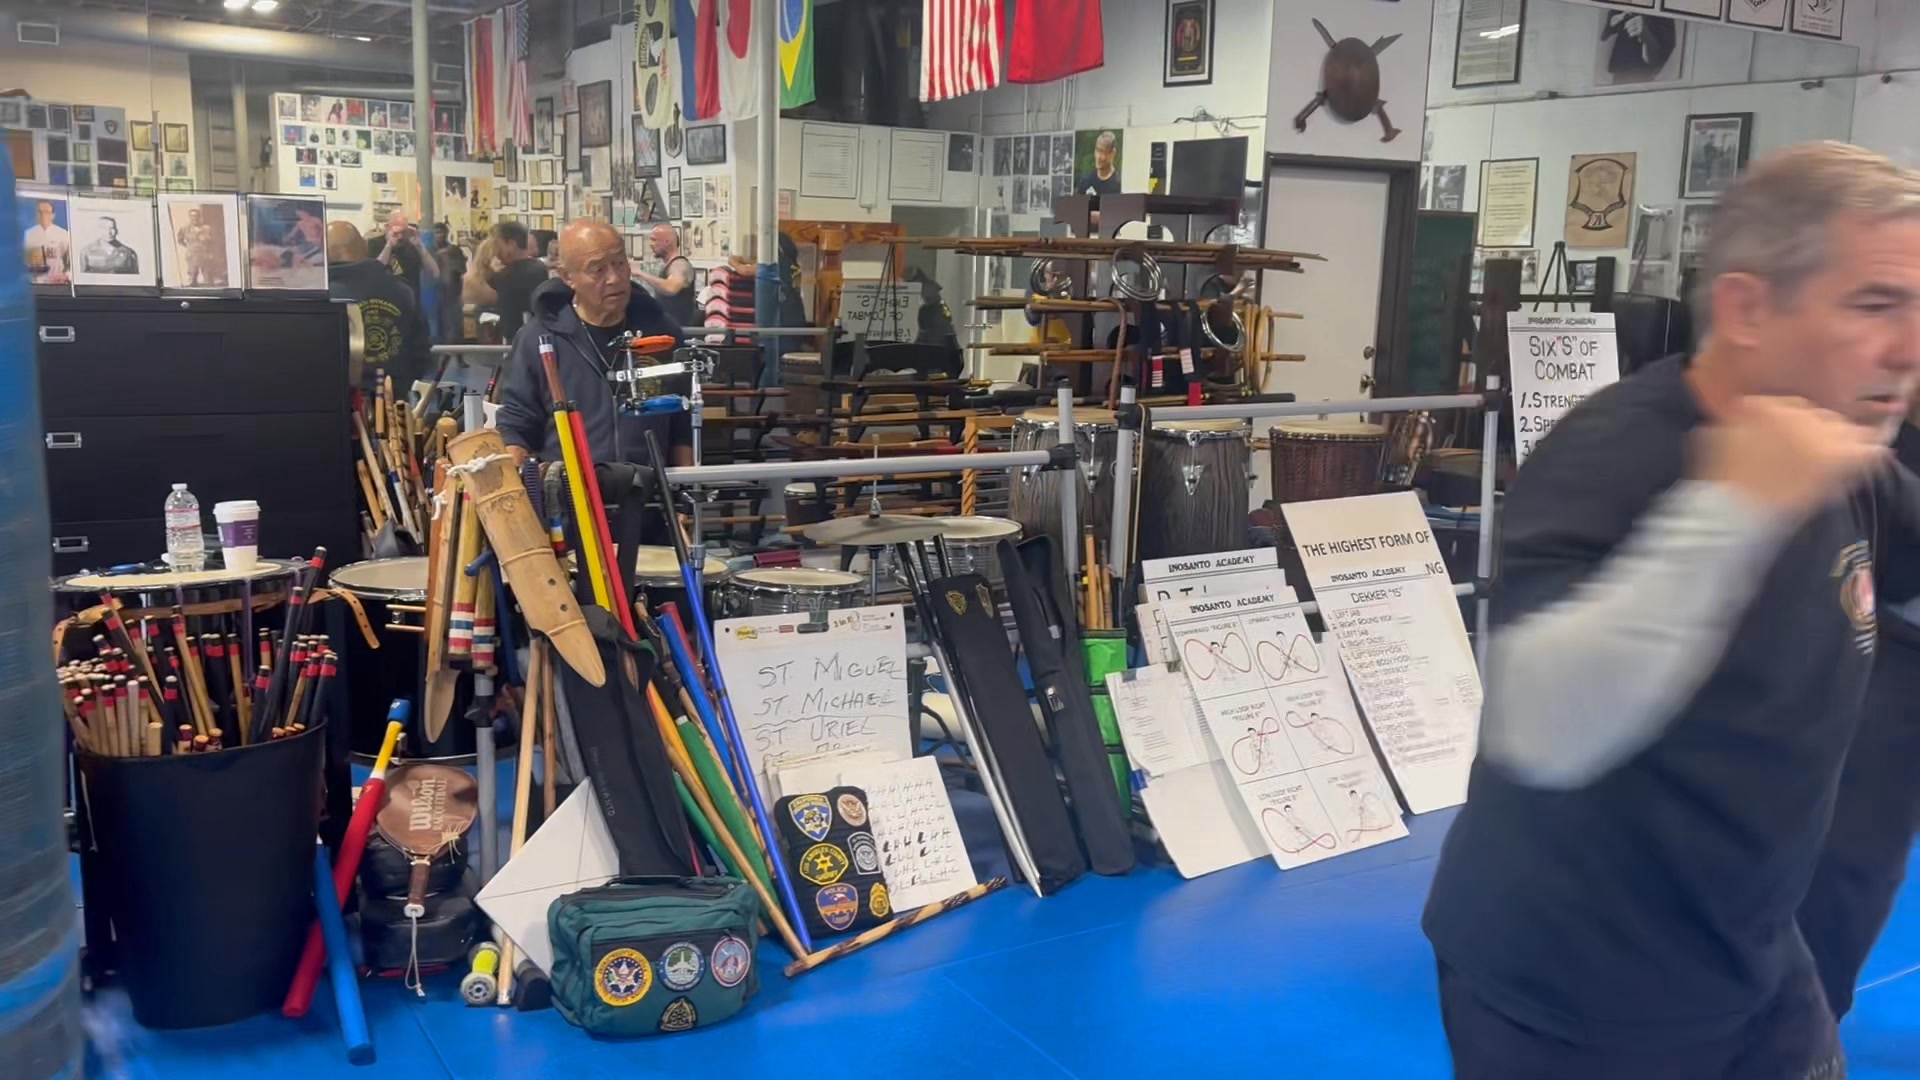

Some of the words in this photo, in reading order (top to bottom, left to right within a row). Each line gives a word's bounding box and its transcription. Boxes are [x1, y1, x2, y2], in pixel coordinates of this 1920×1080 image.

[1580, 341, 1600, 356] OF
[1535, 360, 1596, 381] COMBAT
[1302, 543, 1328, 557] THE
[1329, 537, 1378, 554] HIGHEST
[1379, 533, 1414, 549] FORM
[1415, 530, 1430, 544] OF
[1168, 560, 1211, 573] INOSANTO
[1216, 555, 1255, 567] ACADEMY
[1331, 571, 1368, 583] INOSANTO
[1372, 566, 1407, 577] ACADEMY
[1190, 600, 1232, 613] INOSANTO
[1236, 594, 1275, 607] ACADEMY
[1351, 589, 1388, 604] DEKKER
[814, 652, 908, 681] MIGUEL
[801, 688, 897, 714] MICHAEL
[810, 716, 877, 741] URIEL
[409, 776, 436, 831] Wilson
